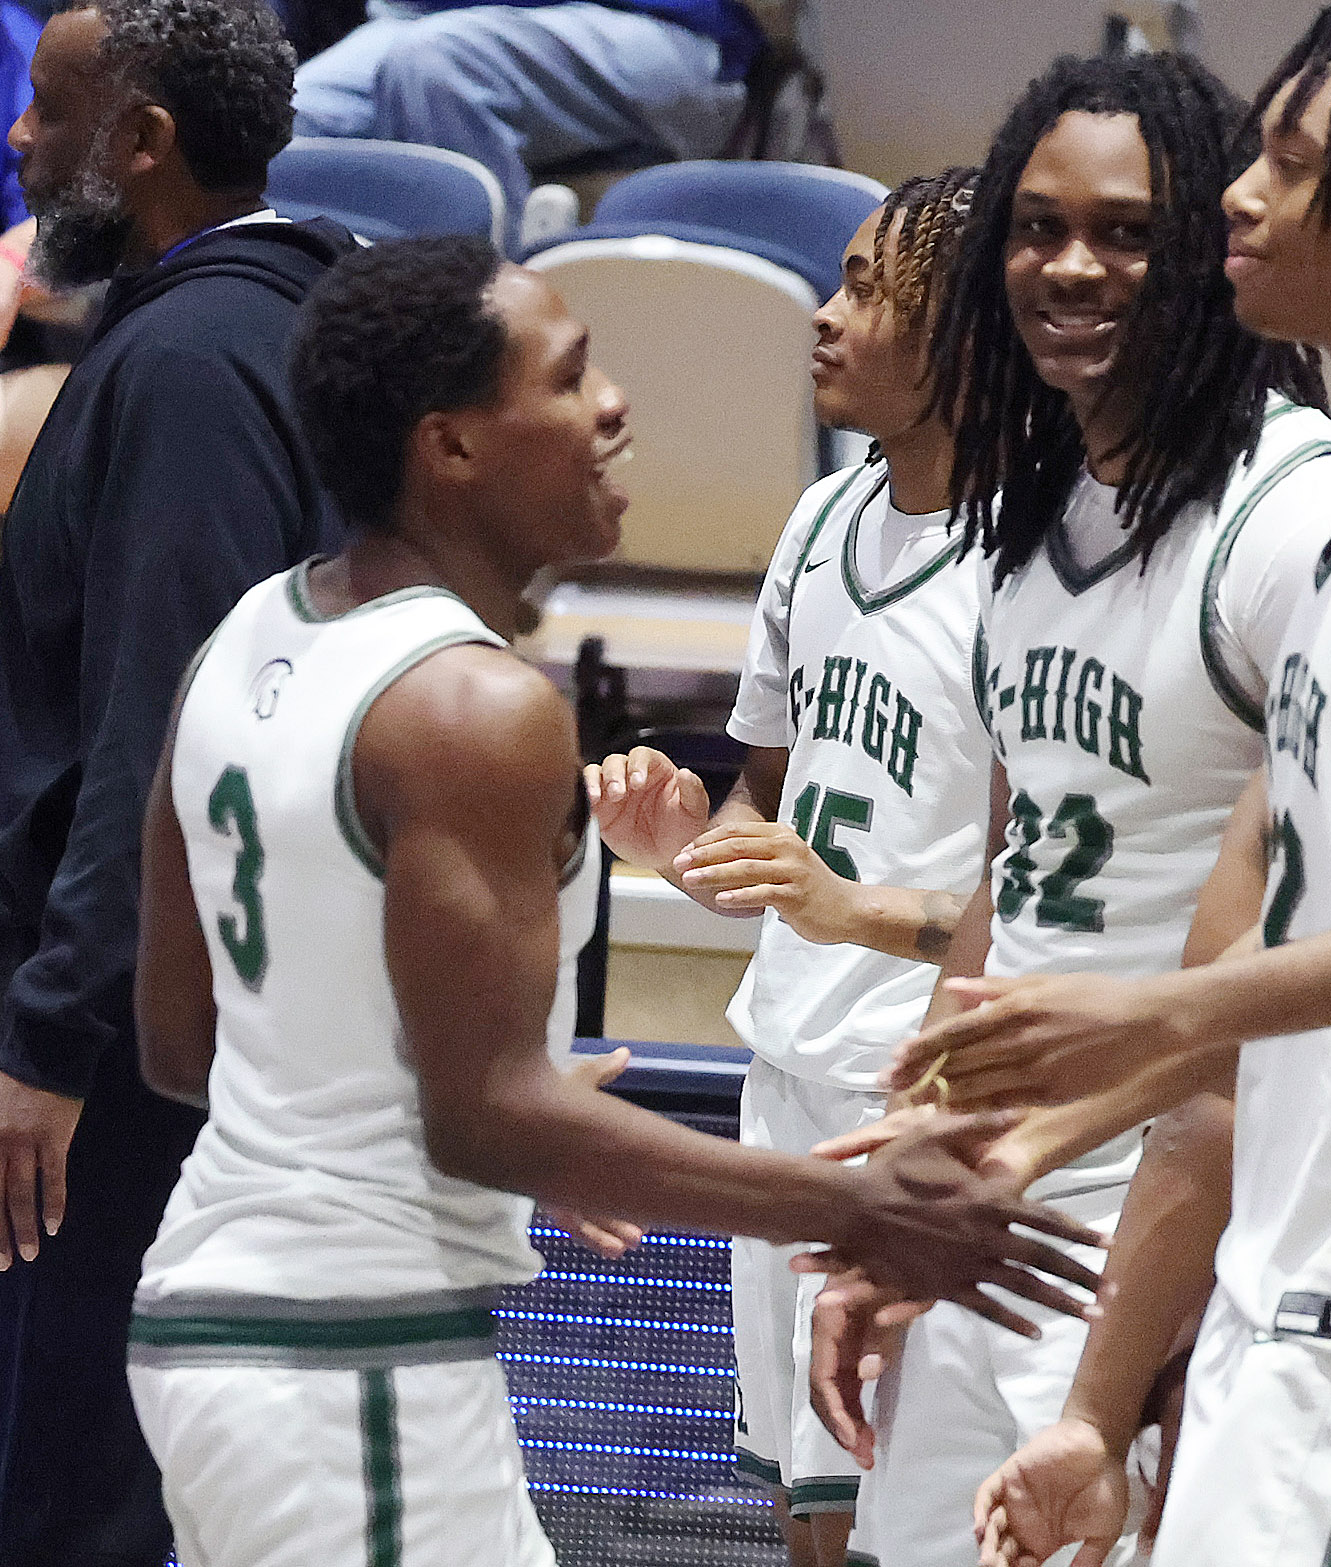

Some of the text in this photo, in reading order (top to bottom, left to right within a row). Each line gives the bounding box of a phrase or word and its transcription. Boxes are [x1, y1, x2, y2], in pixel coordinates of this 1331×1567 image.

[208, 763, 269, 994] 3
[791, 781, 875, 884] 15
[997, 788, 1115, 933] 32
